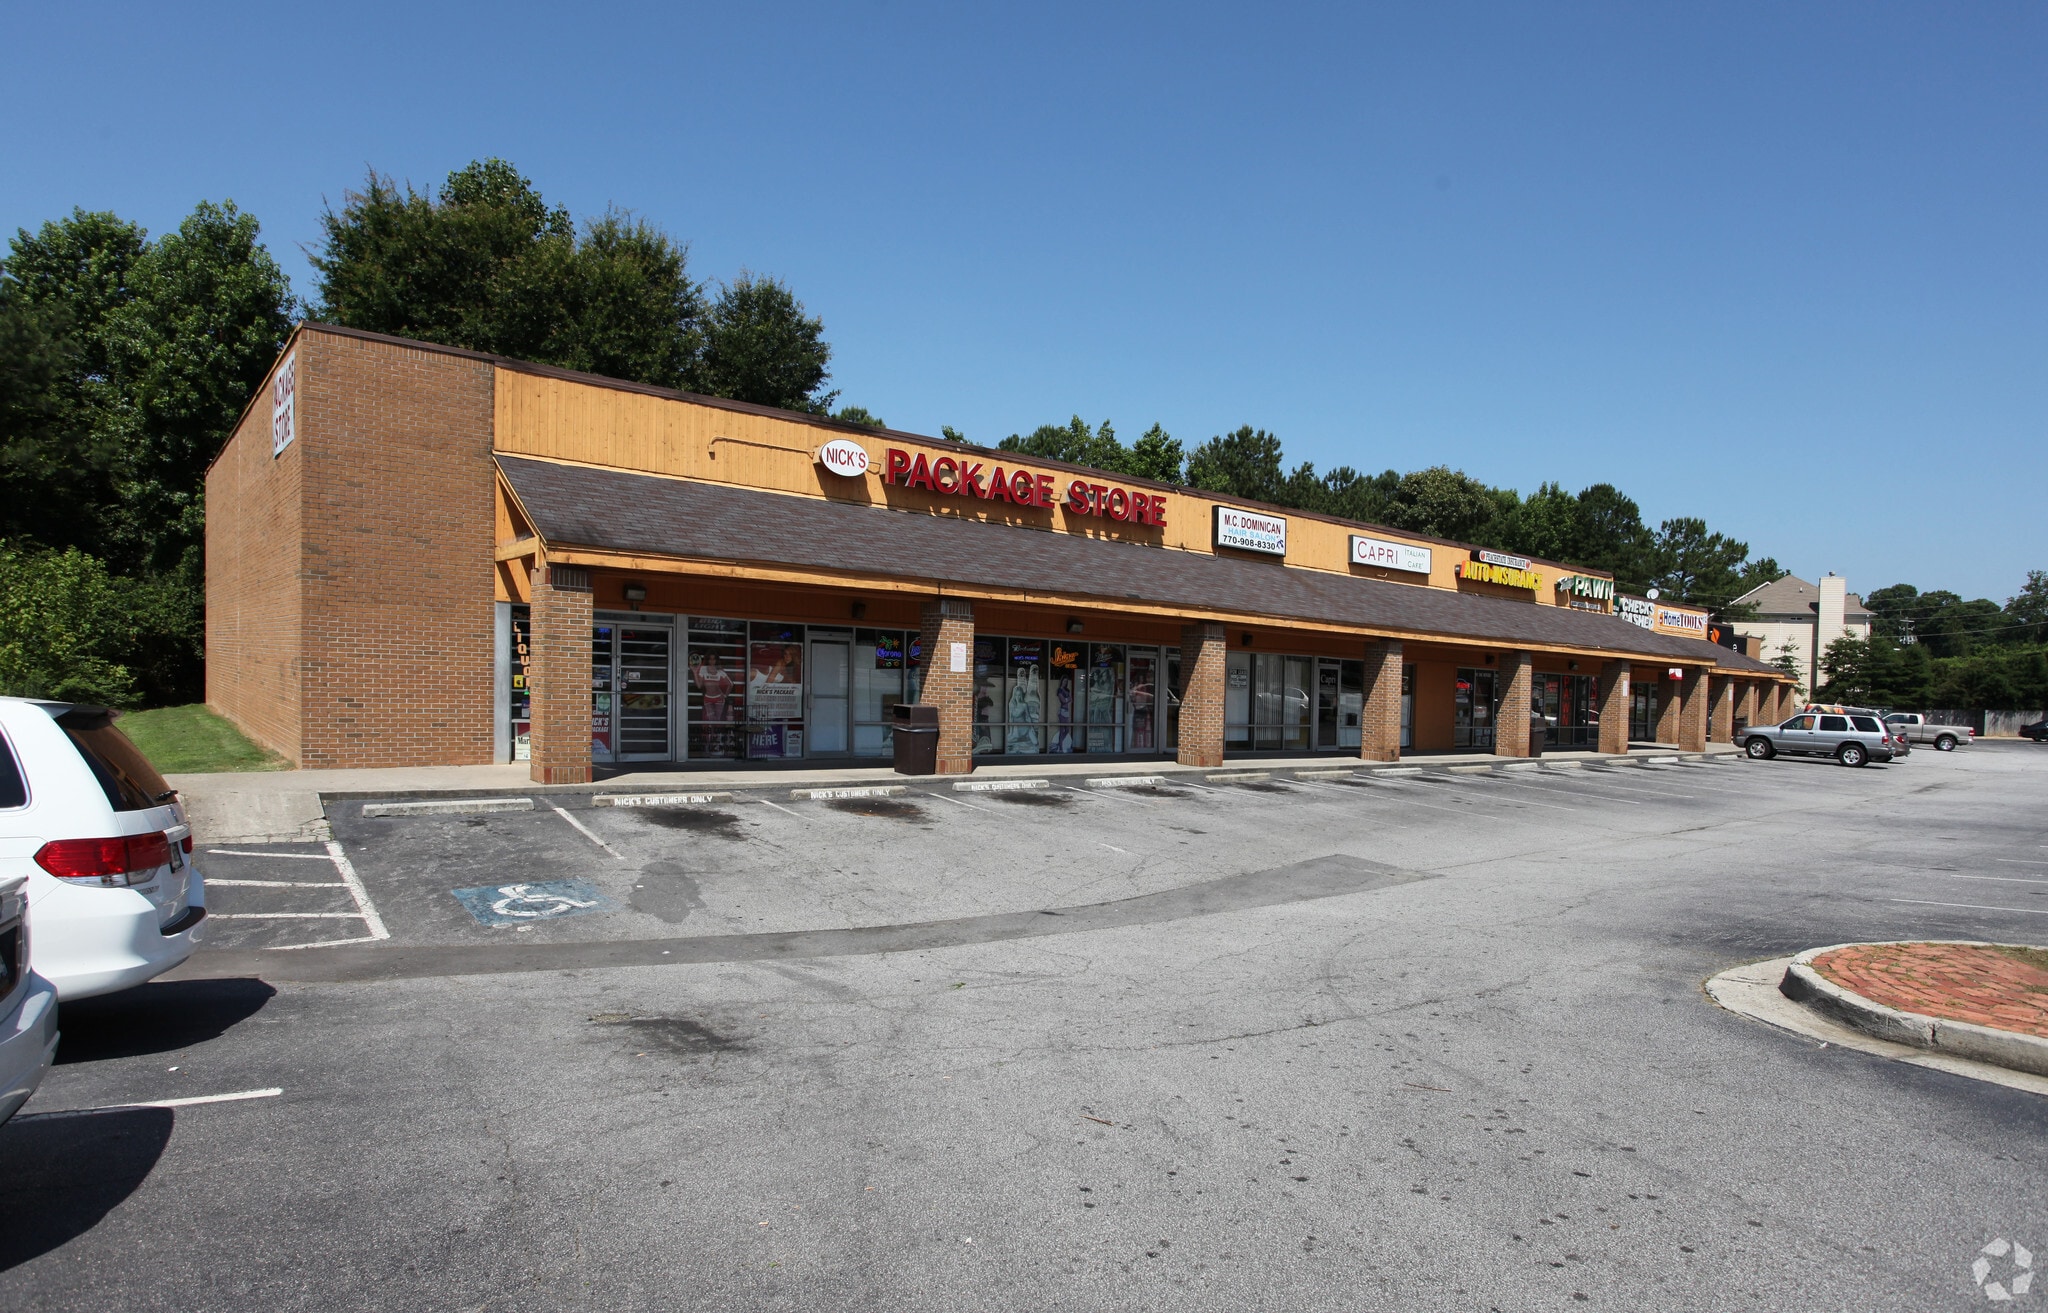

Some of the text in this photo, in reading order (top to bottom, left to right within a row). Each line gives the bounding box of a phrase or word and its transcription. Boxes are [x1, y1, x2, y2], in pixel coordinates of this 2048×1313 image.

[825, 446, 867, 469] NICK'S
[885, 447, 1168, 527] PACKAGE STORE
[1224, 514, 1282, 535] M.C. DOMINICAN
[1223, 534, 1276, 551] 770-908-8330
[1228, 527, 1276, 542] HAIR SALON
[1357, 540, 1399, 564] CAPRI
[1404, 549, 1426, 559] ITALIAN
[1464, 560, 1543, 591] AUTO INSURANCE
[1573, 575, 1614, 600] PAWN
[1621, 596, 1655, 616] CHECKS
[1620, 611, 1655, 630] CASHED
[876, 647, 902, 658] Corona
[1320, 674, 1336, 685] Capri
[1562, 676, 1570, 726] PAWN
[592, 717, 609, 727] ICK'S
[752, 733, 778, 747] HERE
[614, 797, 641, 806] NICK'S
[690, 795, 713, 804] ONLY
[811, 788, 890, 799] NICK'S CUSTOMERS ONLY
